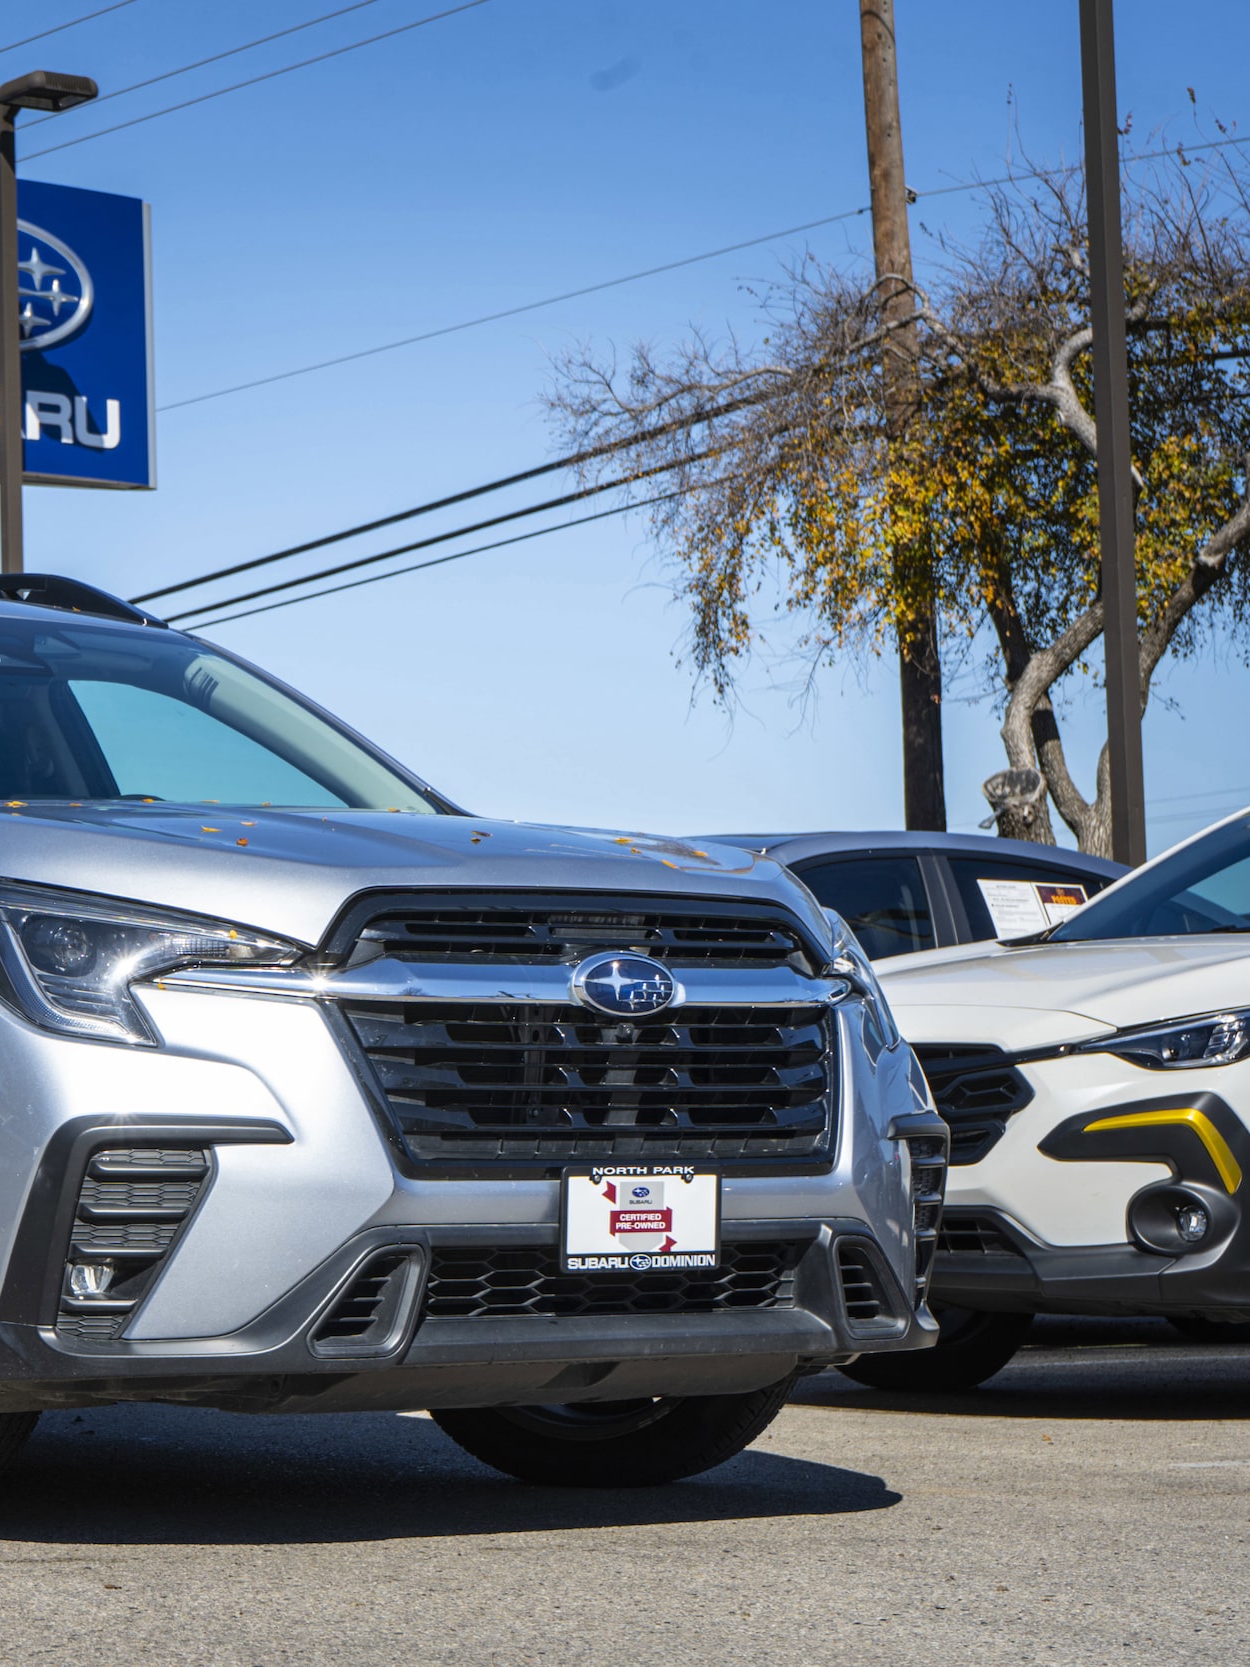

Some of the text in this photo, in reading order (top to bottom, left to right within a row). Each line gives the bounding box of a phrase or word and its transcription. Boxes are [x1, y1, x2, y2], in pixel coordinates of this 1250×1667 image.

[592, 1166, 695, 1175] NORTH PARK
[619, 1213, 662, 1221] CERTIFIED
[615, 1221, 666, 1230] PRE-OWNED
[567, 1254, 716, 1269] SUBARU DOMINION
